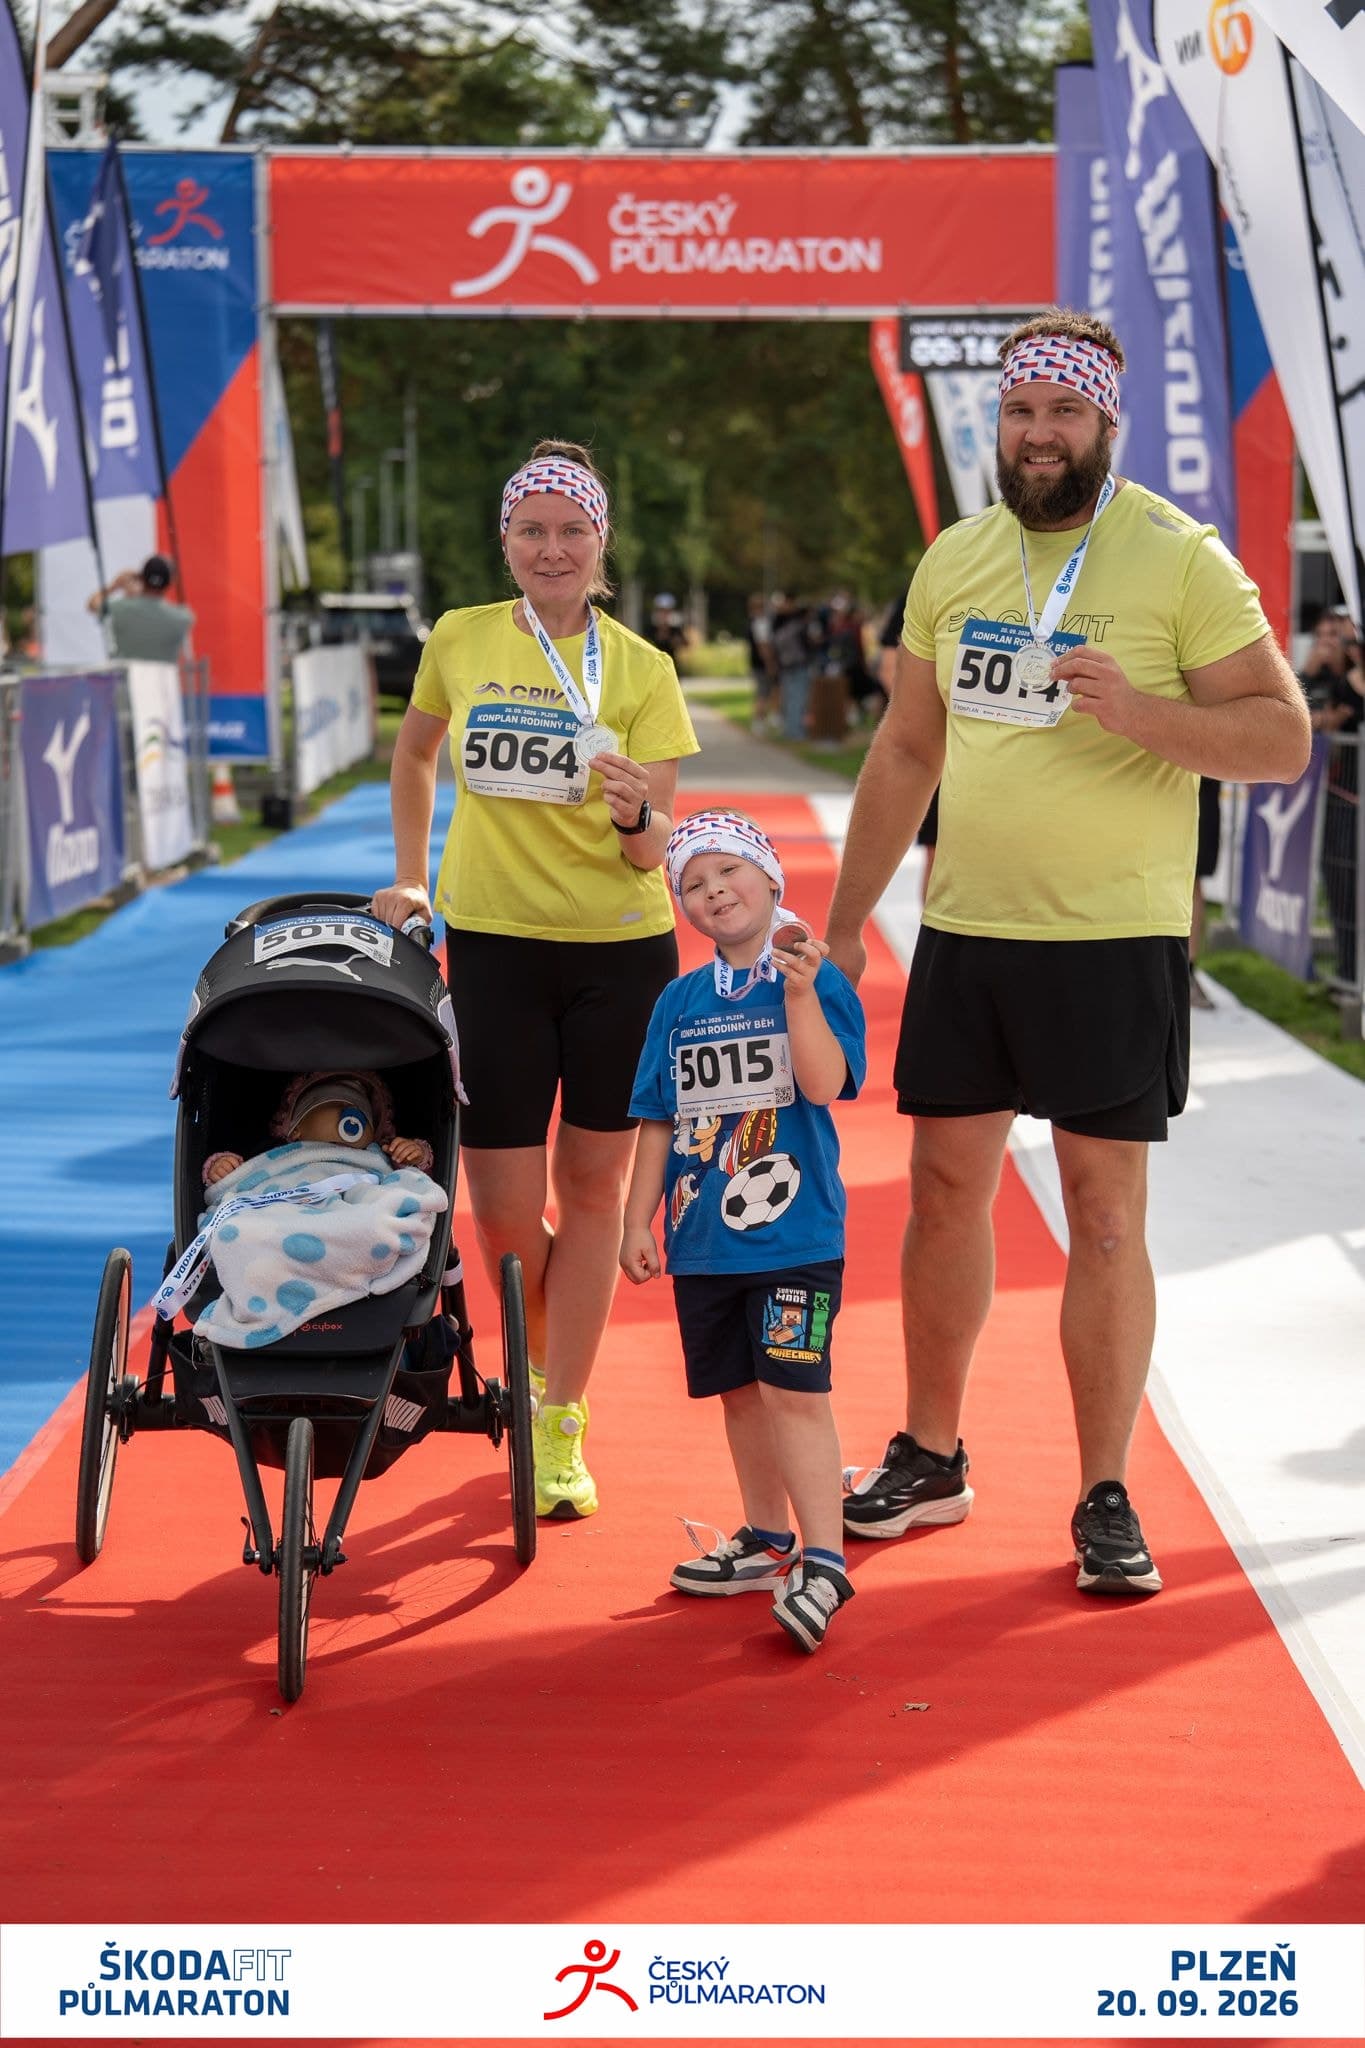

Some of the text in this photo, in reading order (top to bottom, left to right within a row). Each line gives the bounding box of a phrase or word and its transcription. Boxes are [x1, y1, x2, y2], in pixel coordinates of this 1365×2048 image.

[607, 193, 738, 236] ČESKÝ
[609, 235, 884, 274] PŮLMARATON
[972, 630, 1012, 645] KONPLAN
[477, 714, 519, 724] KONPLAN
[522, 716, 562, 730] RODINNÝ
[465, 732, 579, 779] 5064
[261, 924, 379, 951] 5016
[707, 1020, 752, 1034] RODINNÝ
[754, 1018, 775, 1029] BĚH
[680, 1039, 774, 1091] 5015
[775, 1293, 807, 1304] MODE
